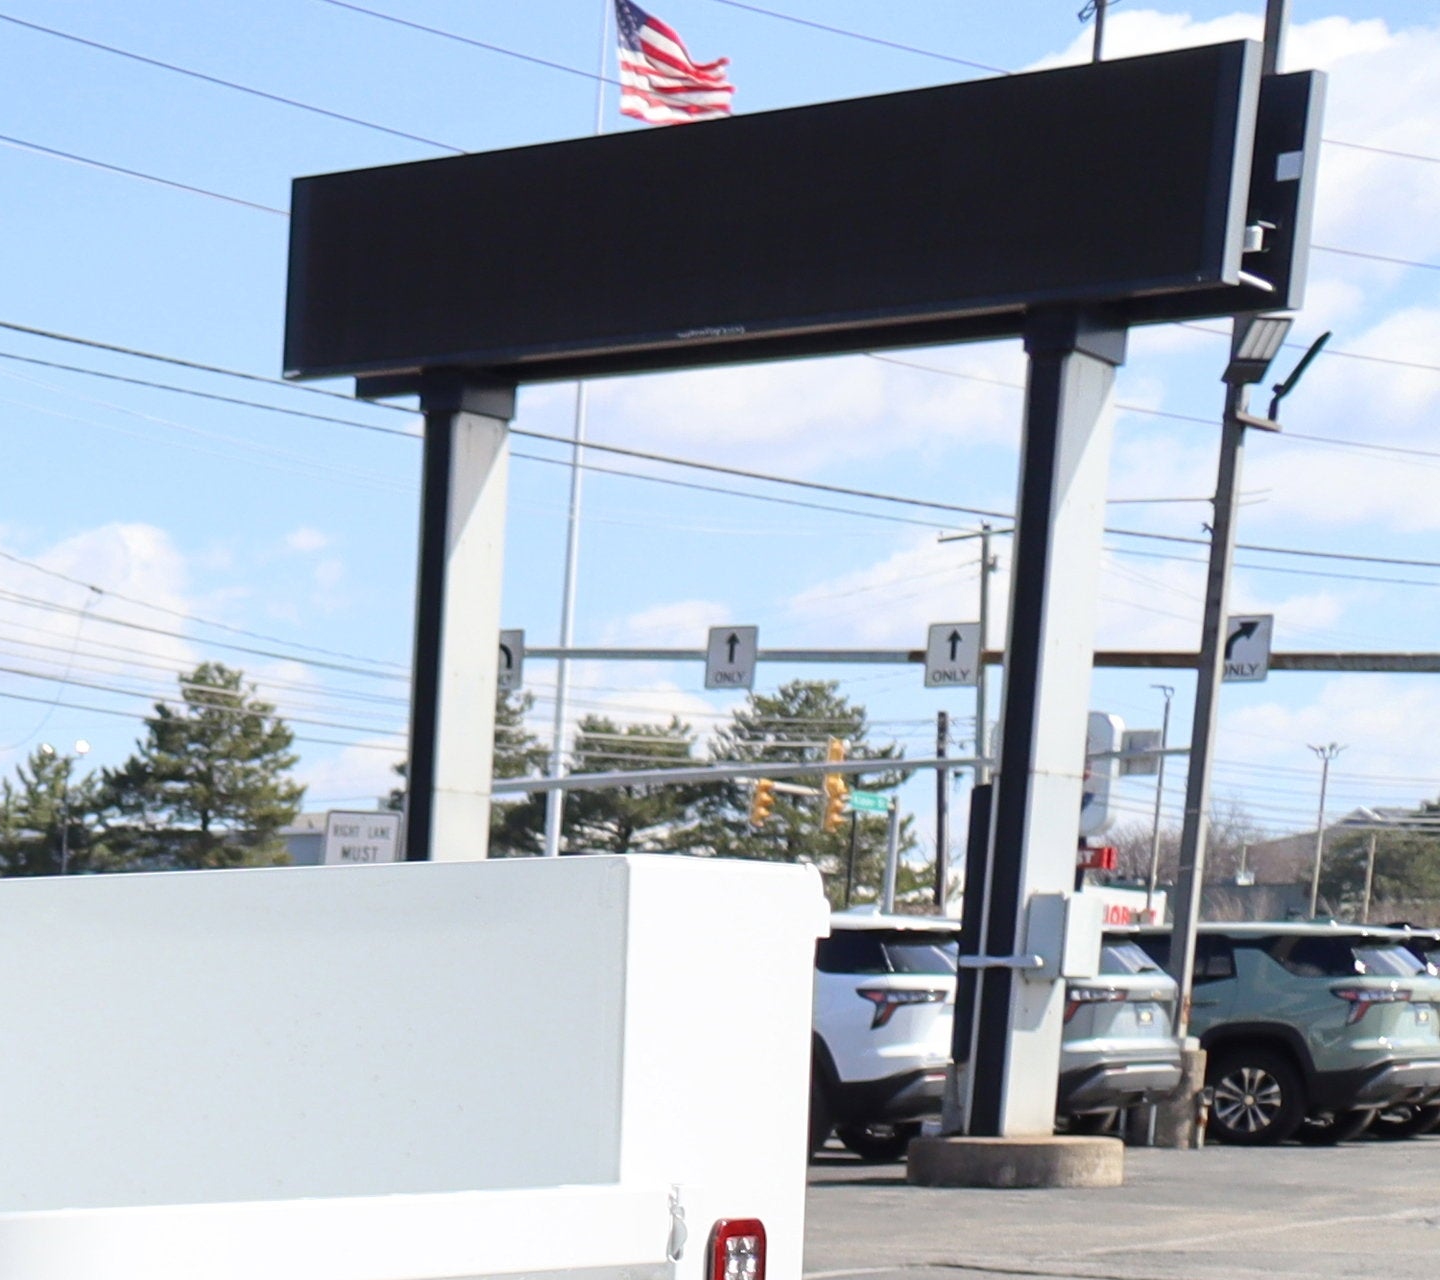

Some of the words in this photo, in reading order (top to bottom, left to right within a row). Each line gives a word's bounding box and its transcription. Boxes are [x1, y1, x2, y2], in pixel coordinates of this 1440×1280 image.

[932, 669, 970, 682] ONLY
[333, 825, 360, 838] RIGHT
[367, 826, 391, 840] LANE
[342, 846, 379, 862] MUST
